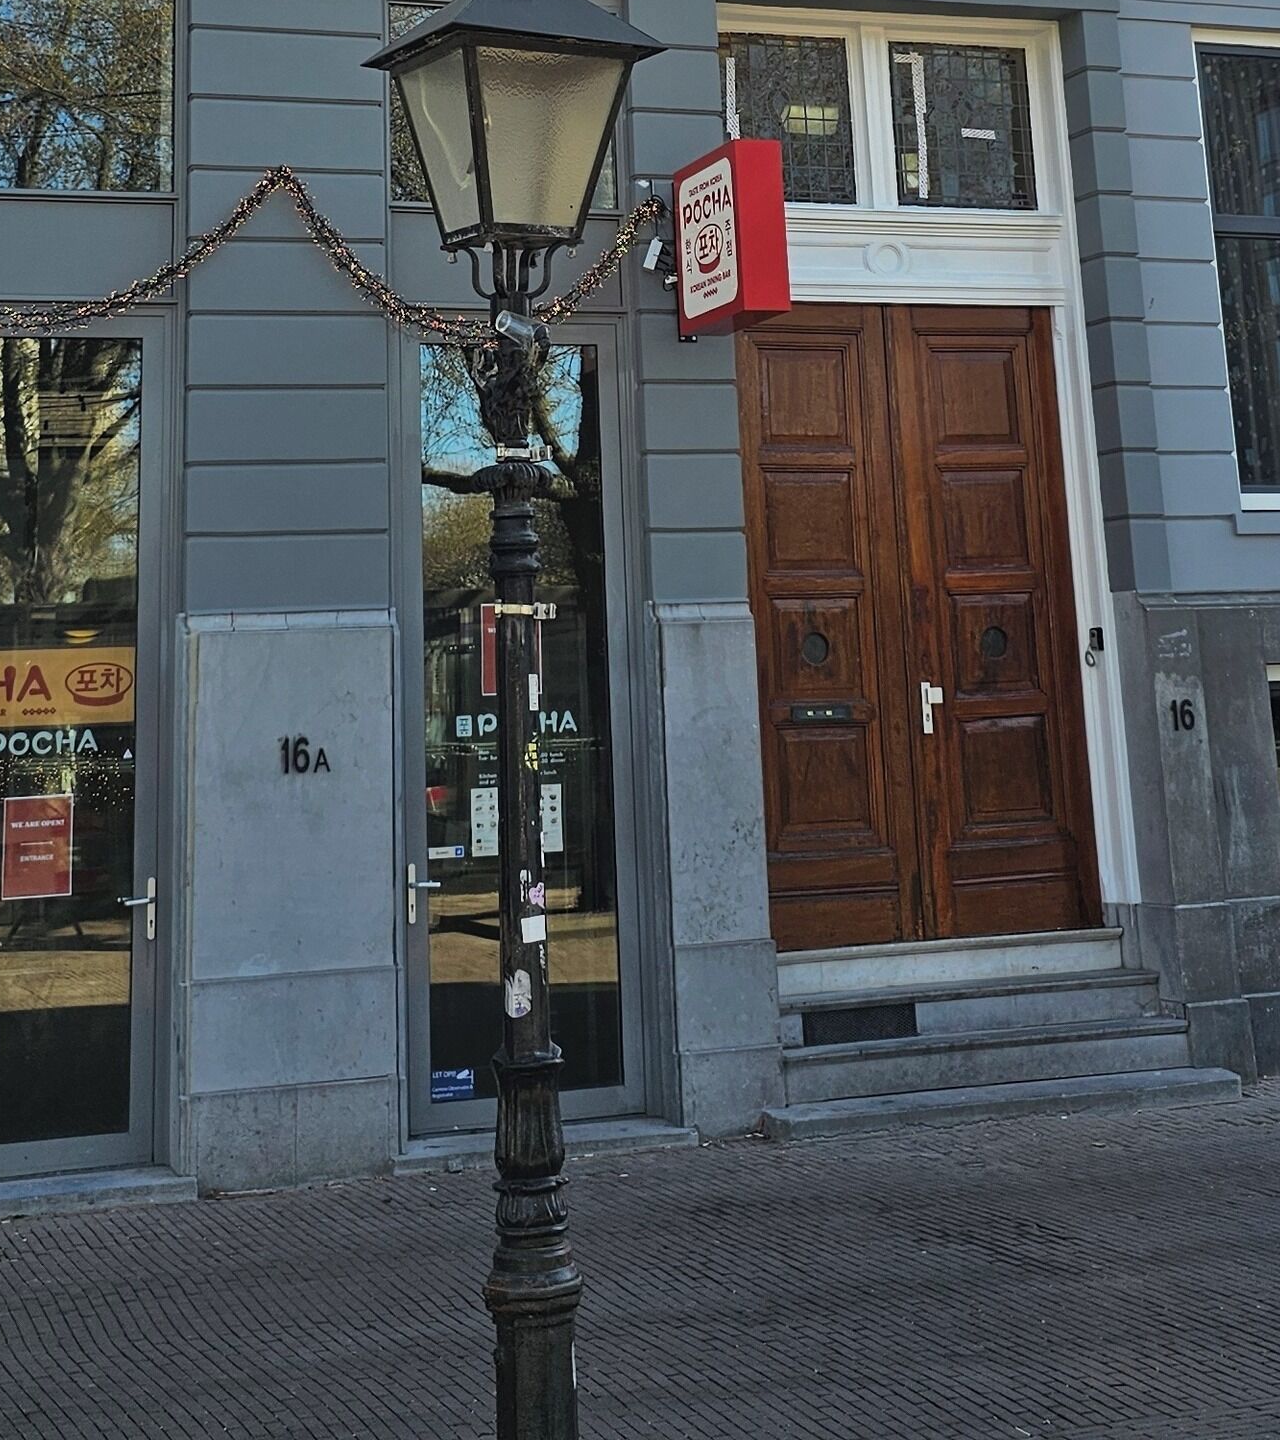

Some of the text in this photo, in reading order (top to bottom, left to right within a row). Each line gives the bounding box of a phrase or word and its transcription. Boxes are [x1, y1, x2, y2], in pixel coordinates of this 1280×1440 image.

[682, 184, 732, 230] POCHA
[699, 228, 719, 260] 포차
[75, 668, 124, 693] 포차
[477, 710, 577, 736] PHA
[1170, 699, 1195, 731] 16
[11, 821, 23, 829] WE
[24, 820, 40, 828] ARE
[20, 854, 54, 862] ENTRANCE
